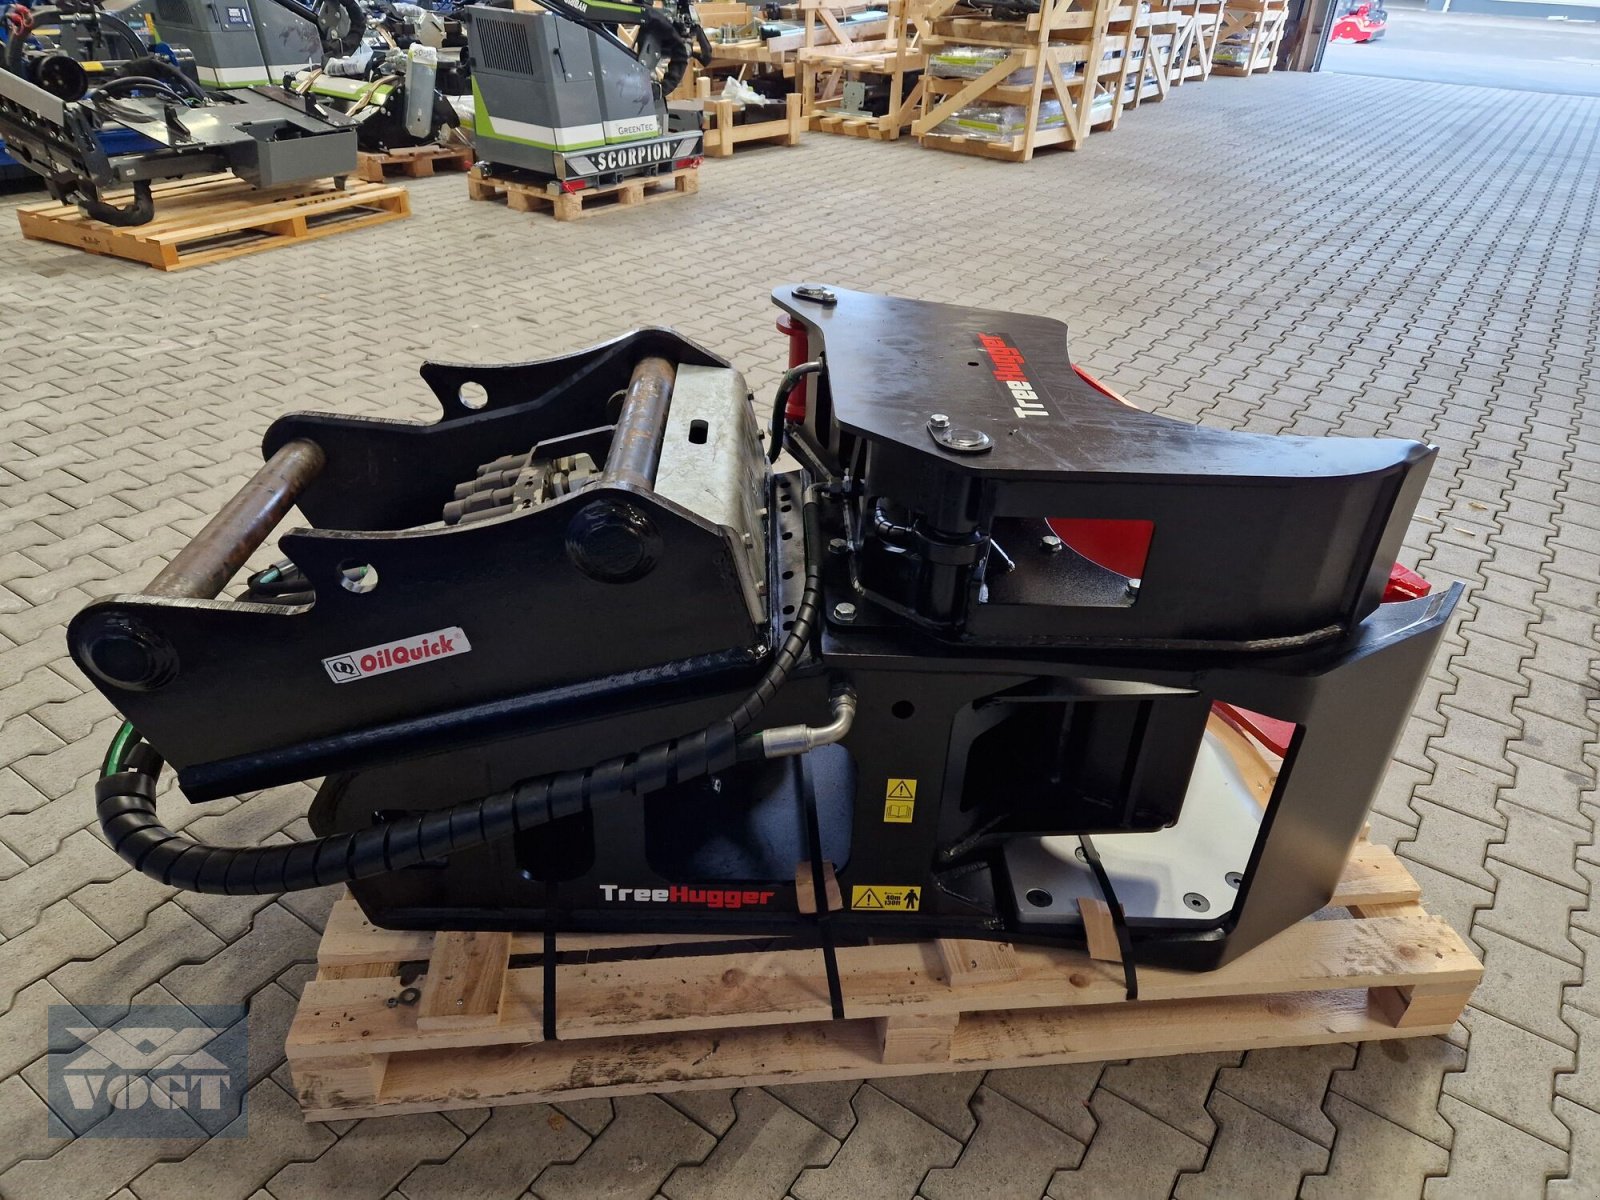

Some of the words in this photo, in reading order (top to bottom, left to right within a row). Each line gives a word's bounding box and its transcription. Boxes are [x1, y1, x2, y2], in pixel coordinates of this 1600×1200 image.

[597, 141, 672, 171] SCORPION
[360, 634, 456, 673] OilQuick
[599, 884, 775, 909] TreeHugger
